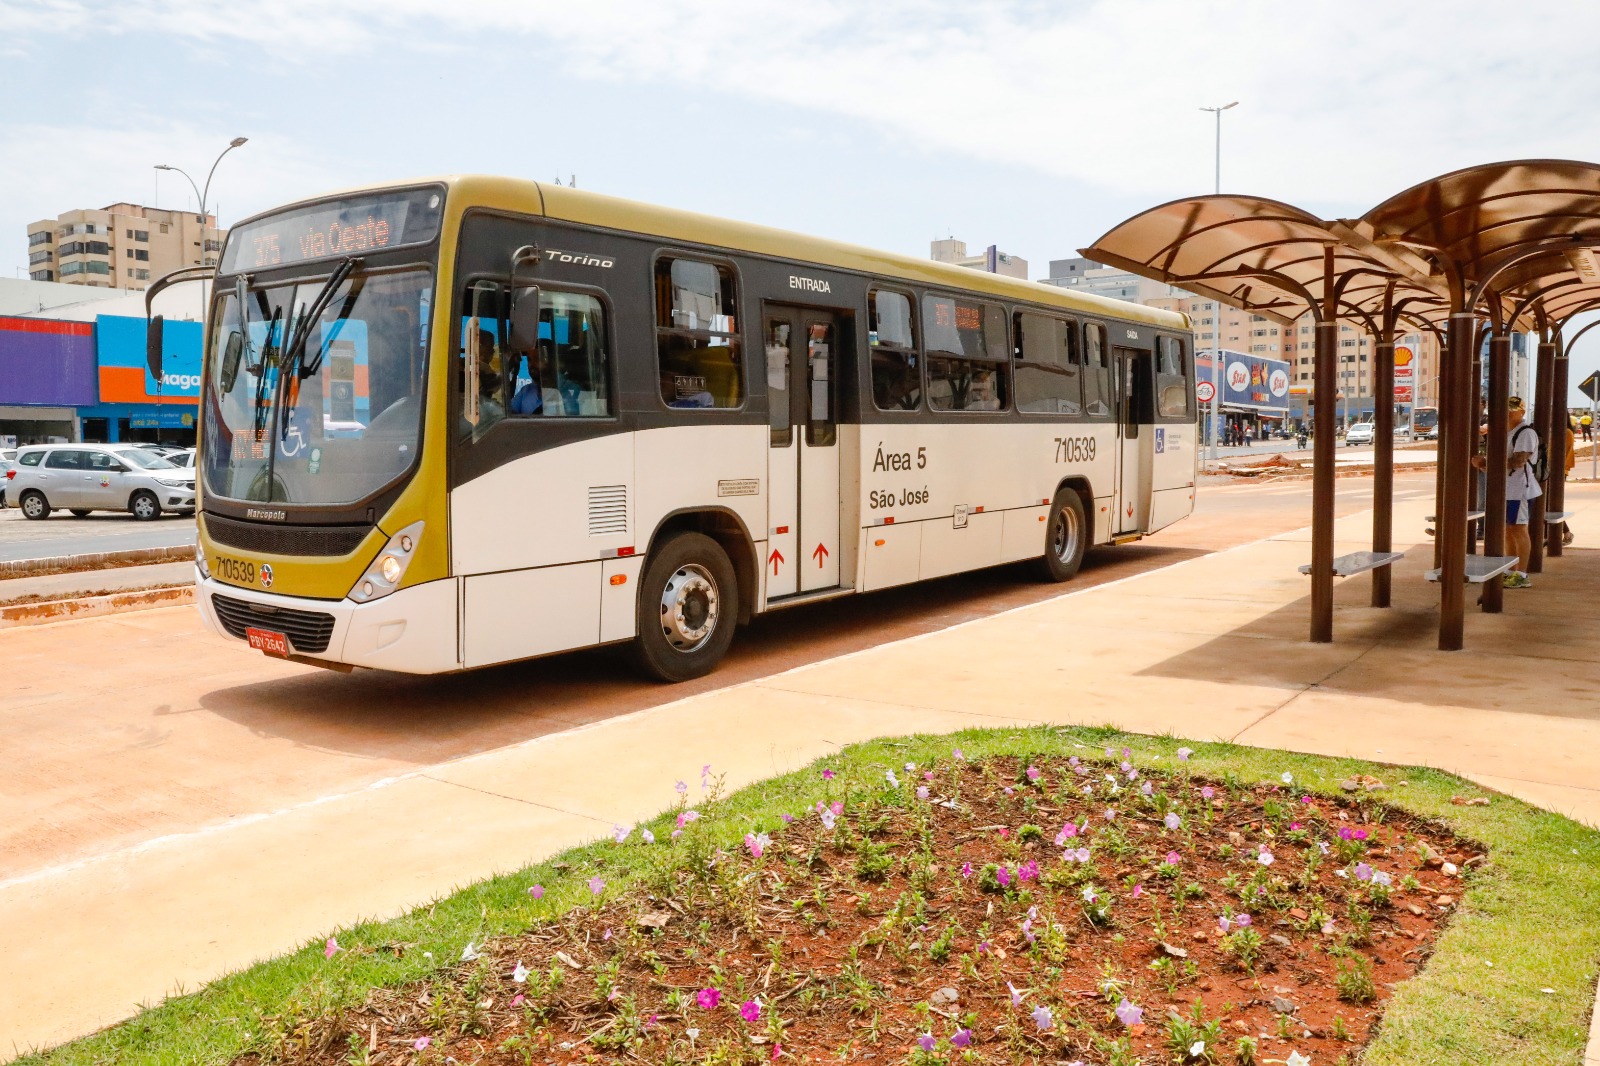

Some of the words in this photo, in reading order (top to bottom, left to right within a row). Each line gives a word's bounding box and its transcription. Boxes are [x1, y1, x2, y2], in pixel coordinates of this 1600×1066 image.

[299, 227, 325, 258] via
[328, 215, 389, 253] Oeste
[545, 250, 614, 268] Torino
[789, 275, 831, 293] ENTRADA
[872, 441, 911, 472] Área
[917, 446, 927, 469] 5
[1054, 436, 1096, 463] 710539
[869, 488, 895, 509] São
[899, 485, 929, 506] José
[247, 508, 285, 520] Marcopolo
[215, 556, 255, 584] 710539
